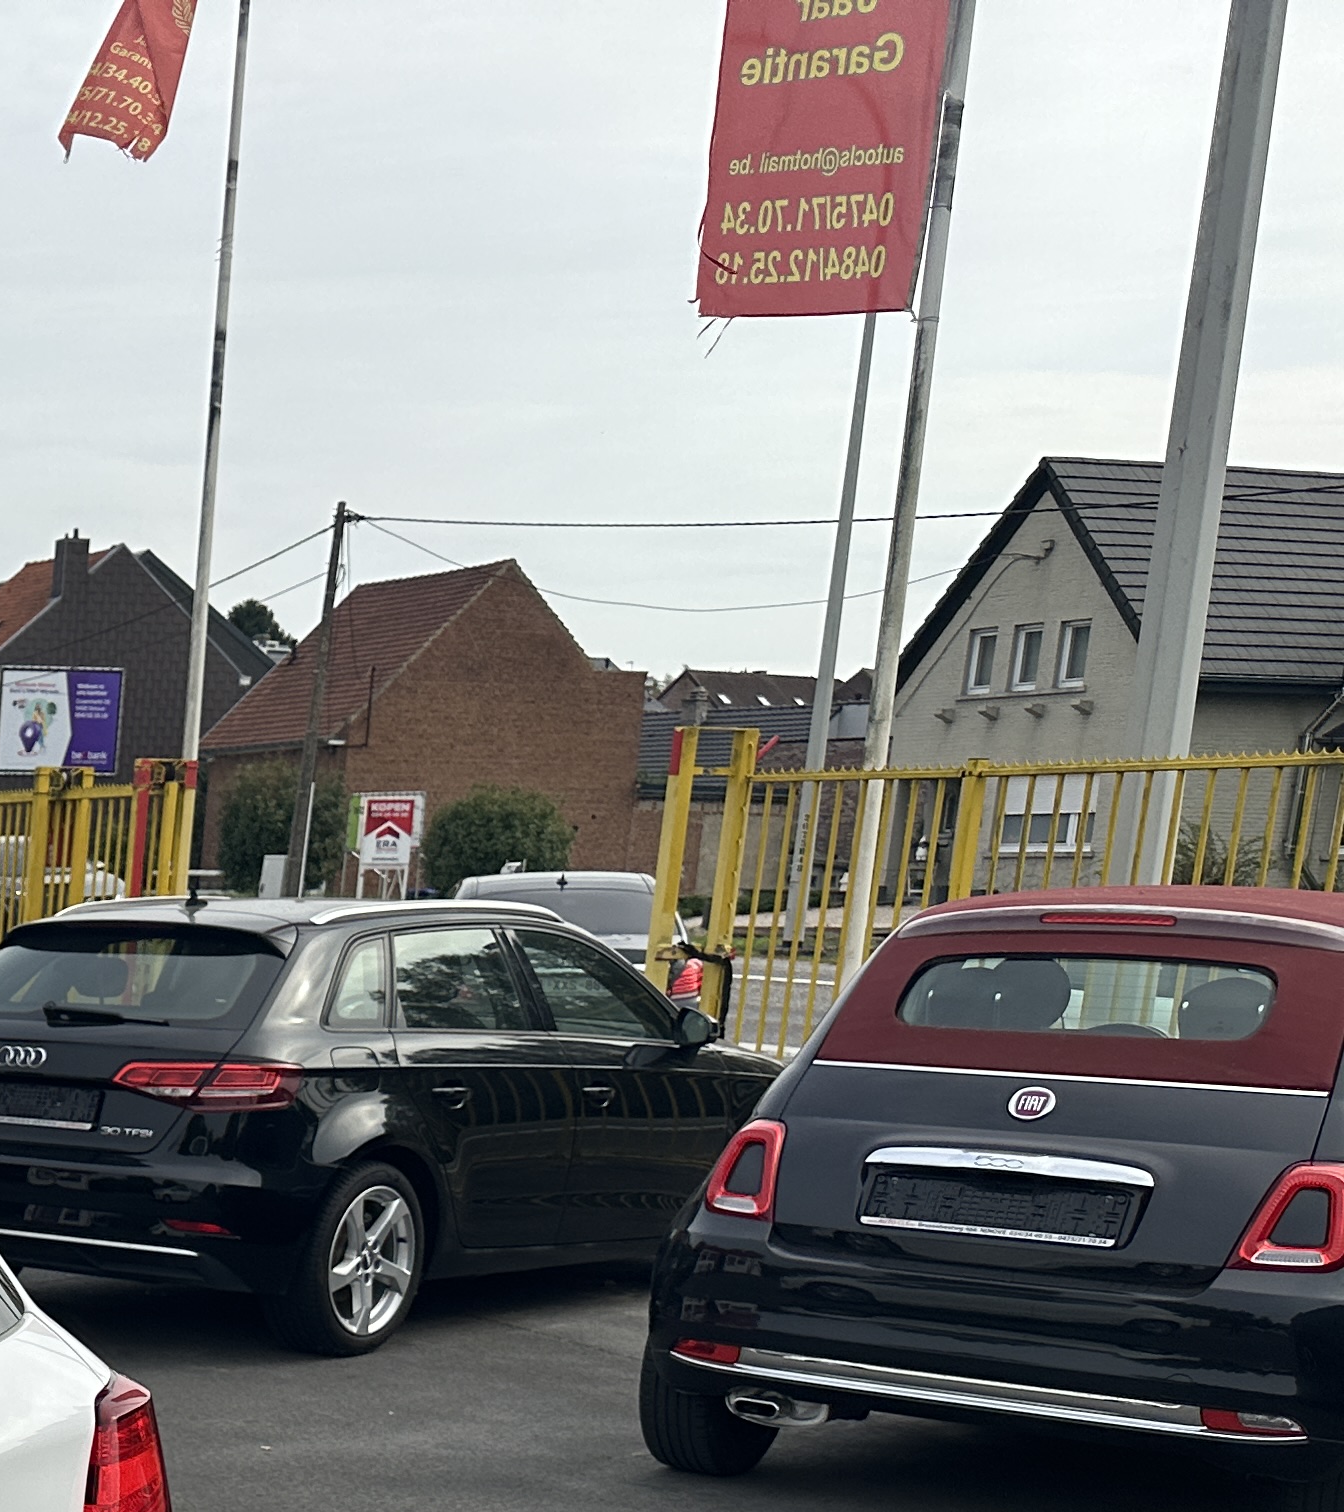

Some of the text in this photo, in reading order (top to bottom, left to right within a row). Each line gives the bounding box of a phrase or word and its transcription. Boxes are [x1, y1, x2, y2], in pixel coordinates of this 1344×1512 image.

[1017, 1095, 1048, 1112] FIAT
[100, 1126, 121, 1136] 30
[973, 1155, 1025, 1169] 500
